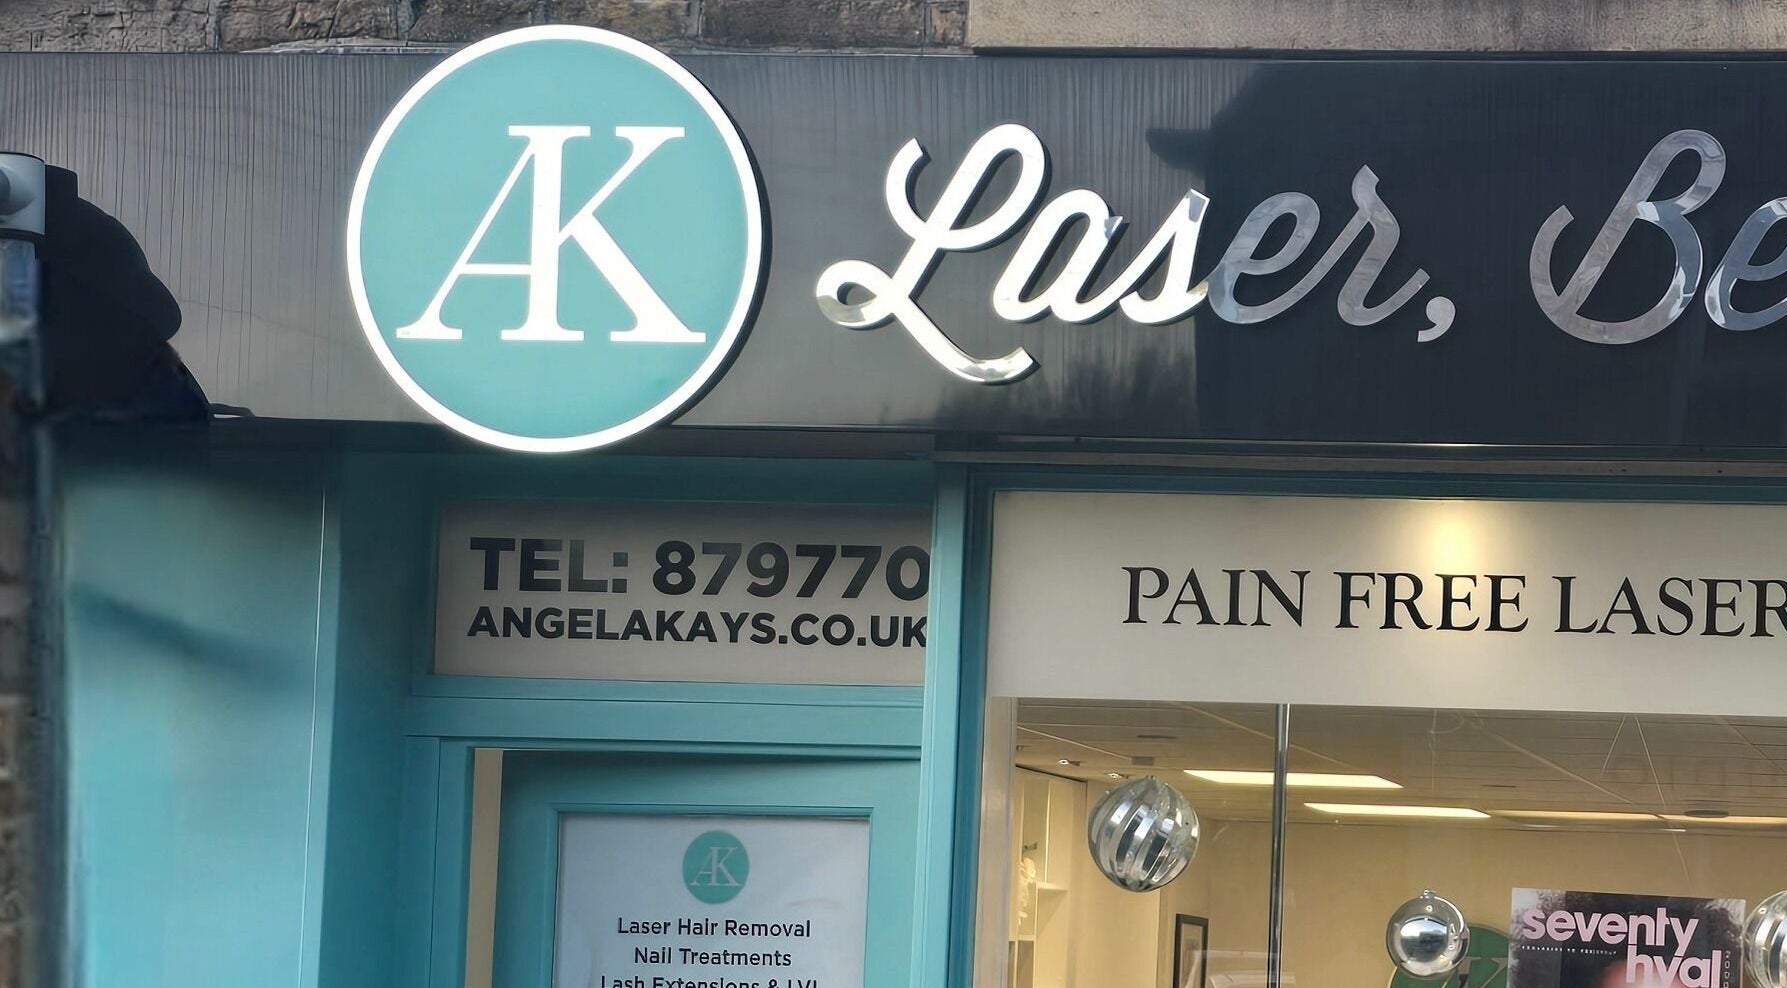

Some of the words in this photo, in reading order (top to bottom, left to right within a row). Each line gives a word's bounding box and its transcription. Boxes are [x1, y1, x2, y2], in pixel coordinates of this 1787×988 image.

[396, 125, 706, 343] AK
[816, 123, 1457, 384] Laser,
[470, 537, 628, 593] TEL:
[652, 540, 930, 600] 879770
[1122, 566, 1311, 627] PAIN
[1333, 571, 1529, 633] FREE
[467, 606, 928, 648] ANGELAKAYS.CO.UK
[690, 846, 740, 887] AK
[618, 917, 671, 935] Laser
[678, 918, 718, 936] Hair
[725, 920, 811, 938] Removal
[1522, 907, 1699, 957] seventy
[634, 947, 672, 965] Nail
[679, 948, 792, 966] Treatments
